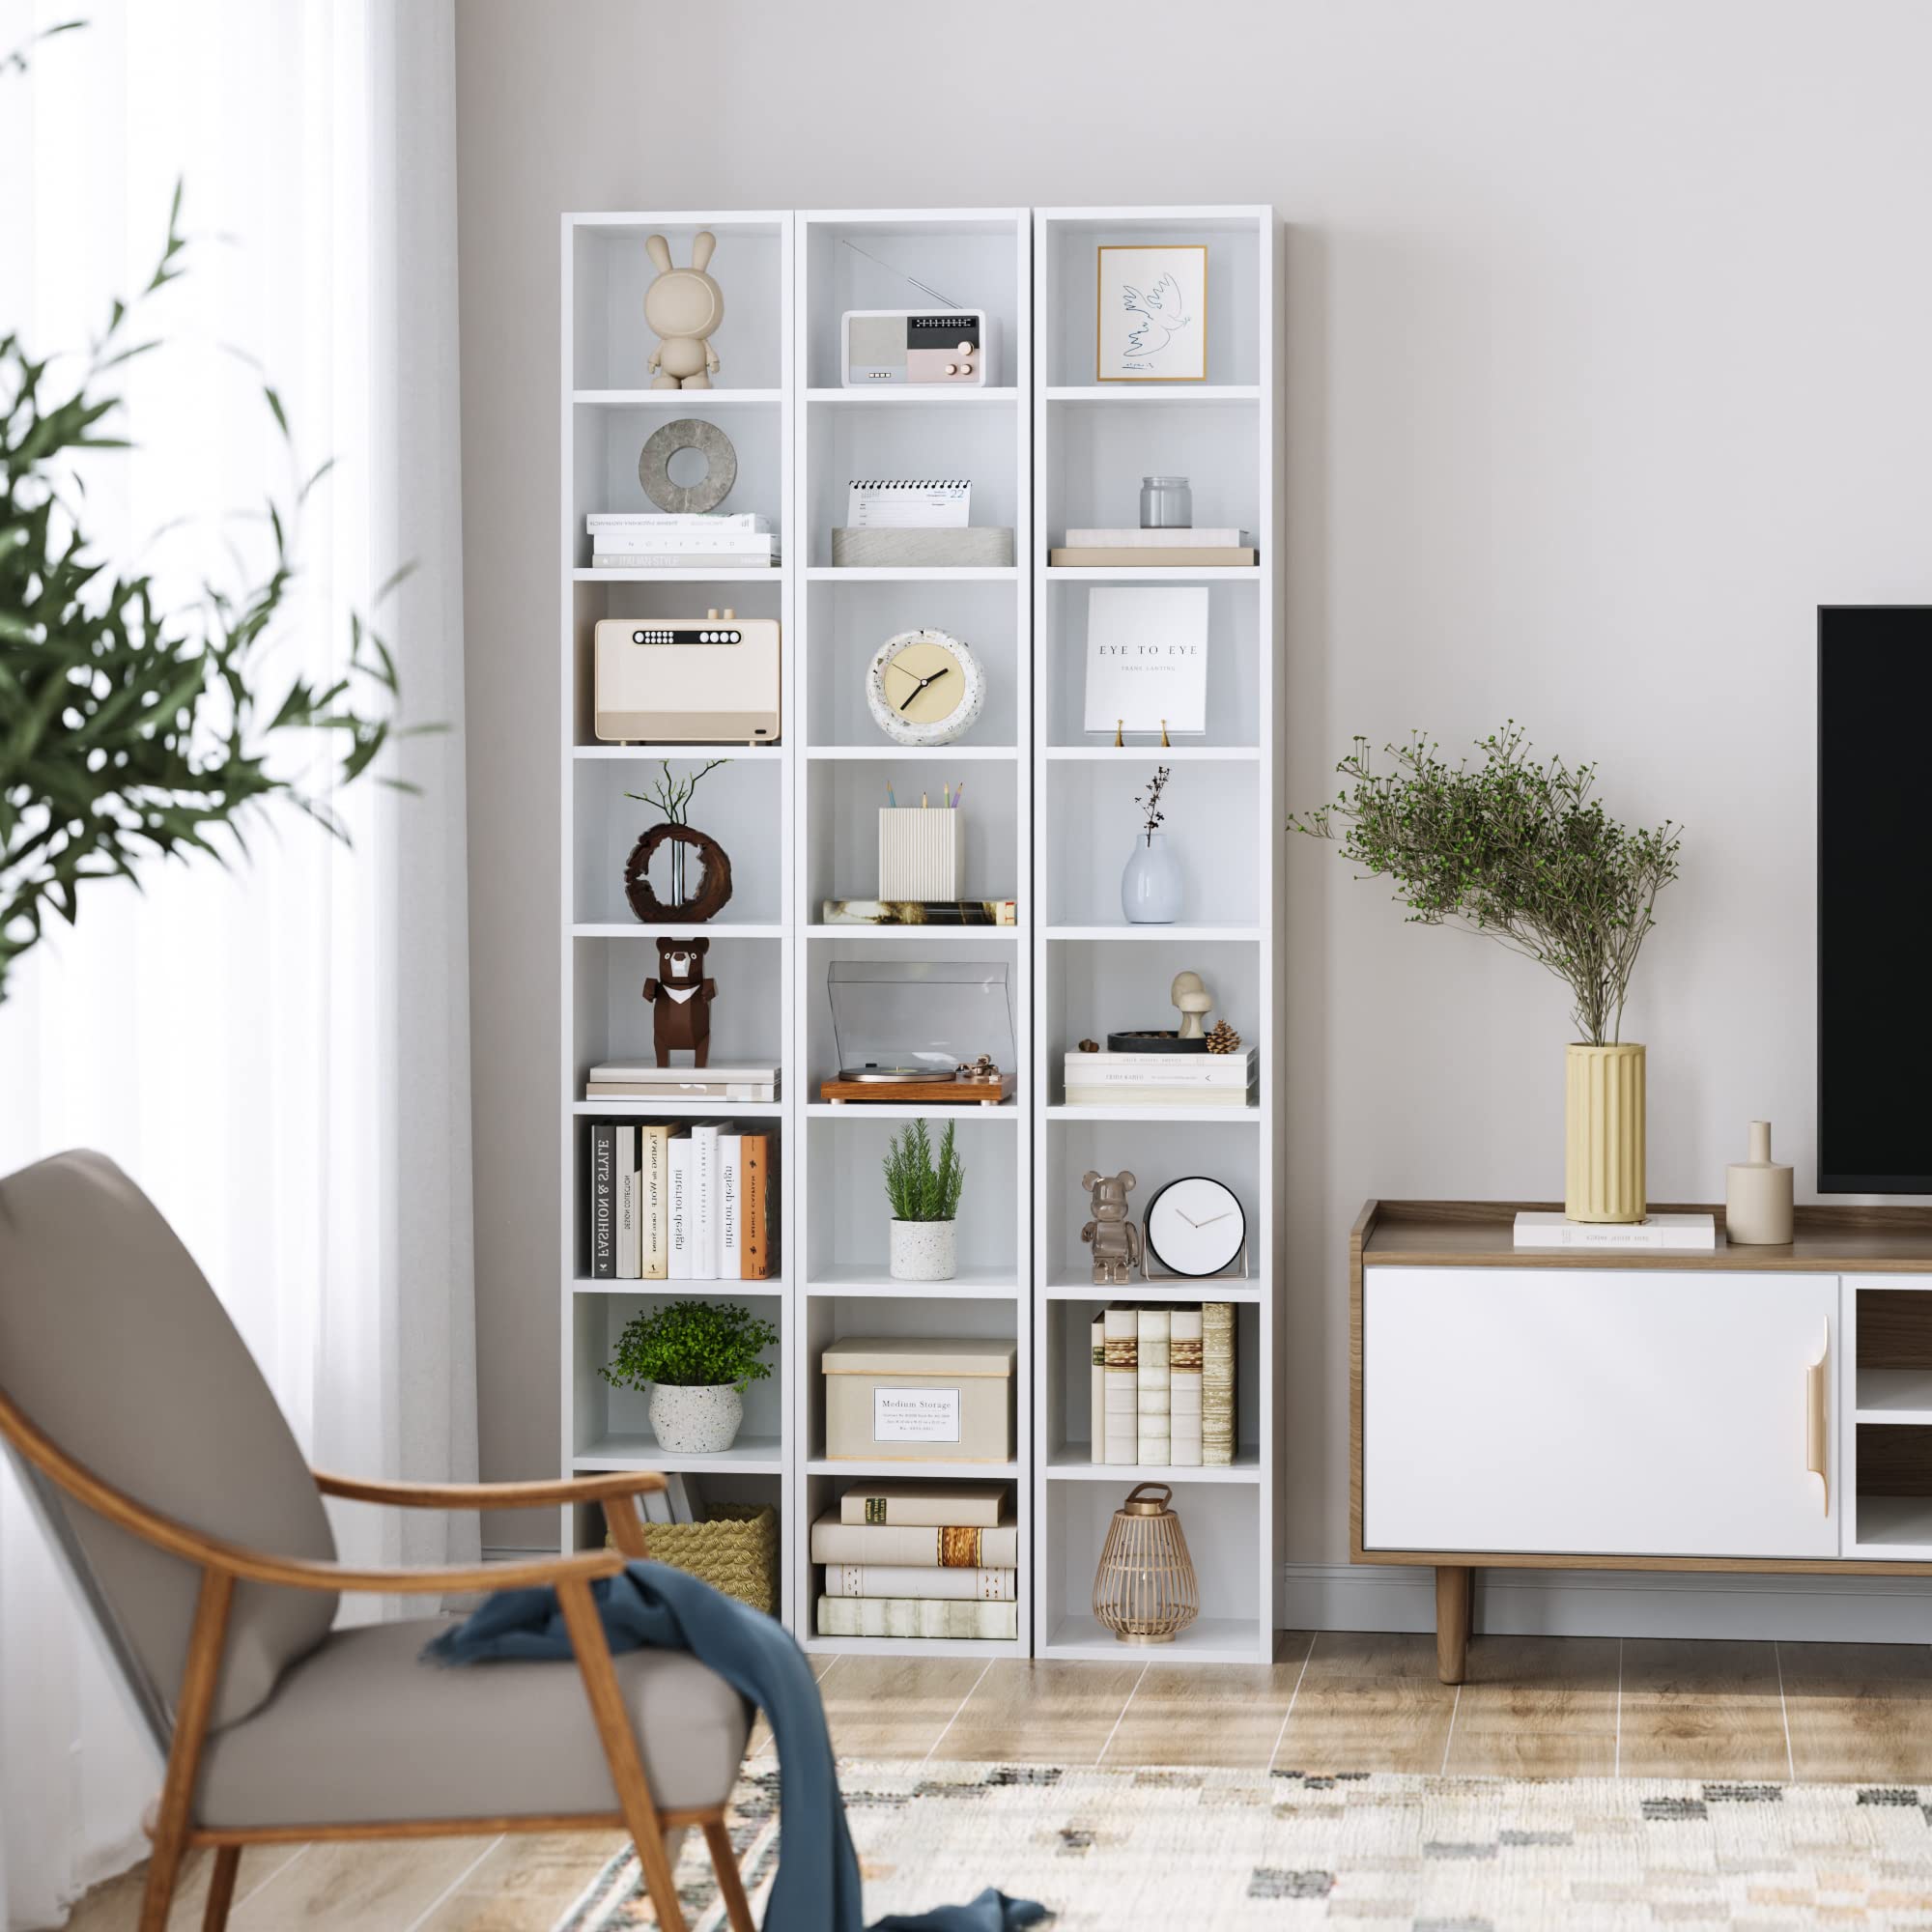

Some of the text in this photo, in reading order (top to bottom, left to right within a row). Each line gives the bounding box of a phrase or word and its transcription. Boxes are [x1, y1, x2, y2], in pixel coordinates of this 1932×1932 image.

[1099, 645, 1198, 655] EYE TO EYE
[919, 1401, 952, 1410] Storage
